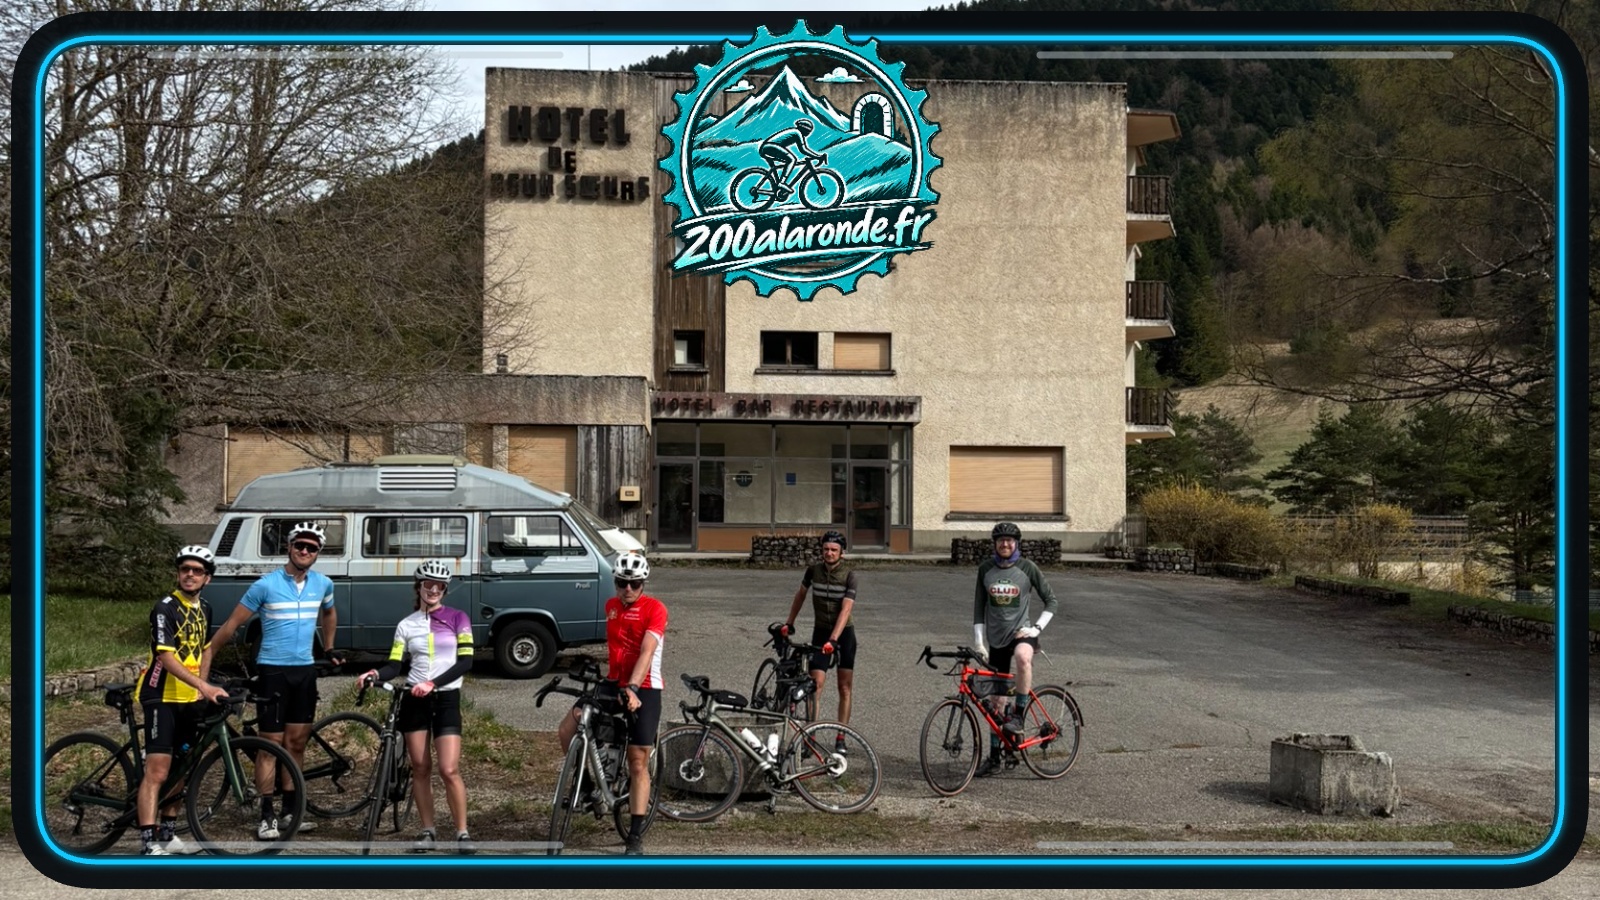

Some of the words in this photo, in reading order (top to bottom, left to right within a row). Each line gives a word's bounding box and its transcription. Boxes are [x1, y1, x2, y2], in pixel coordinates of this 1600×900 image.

[508, 105, 631, 145] HOTEL
[548, 146, 576, 174] DE
[656, 397, 717, 413] HOTEL
[737, 399, 772, 414] BAR
[794, 399, 917, 415] RESTAURANT
[990, 587, 1019, 595] CLUB
